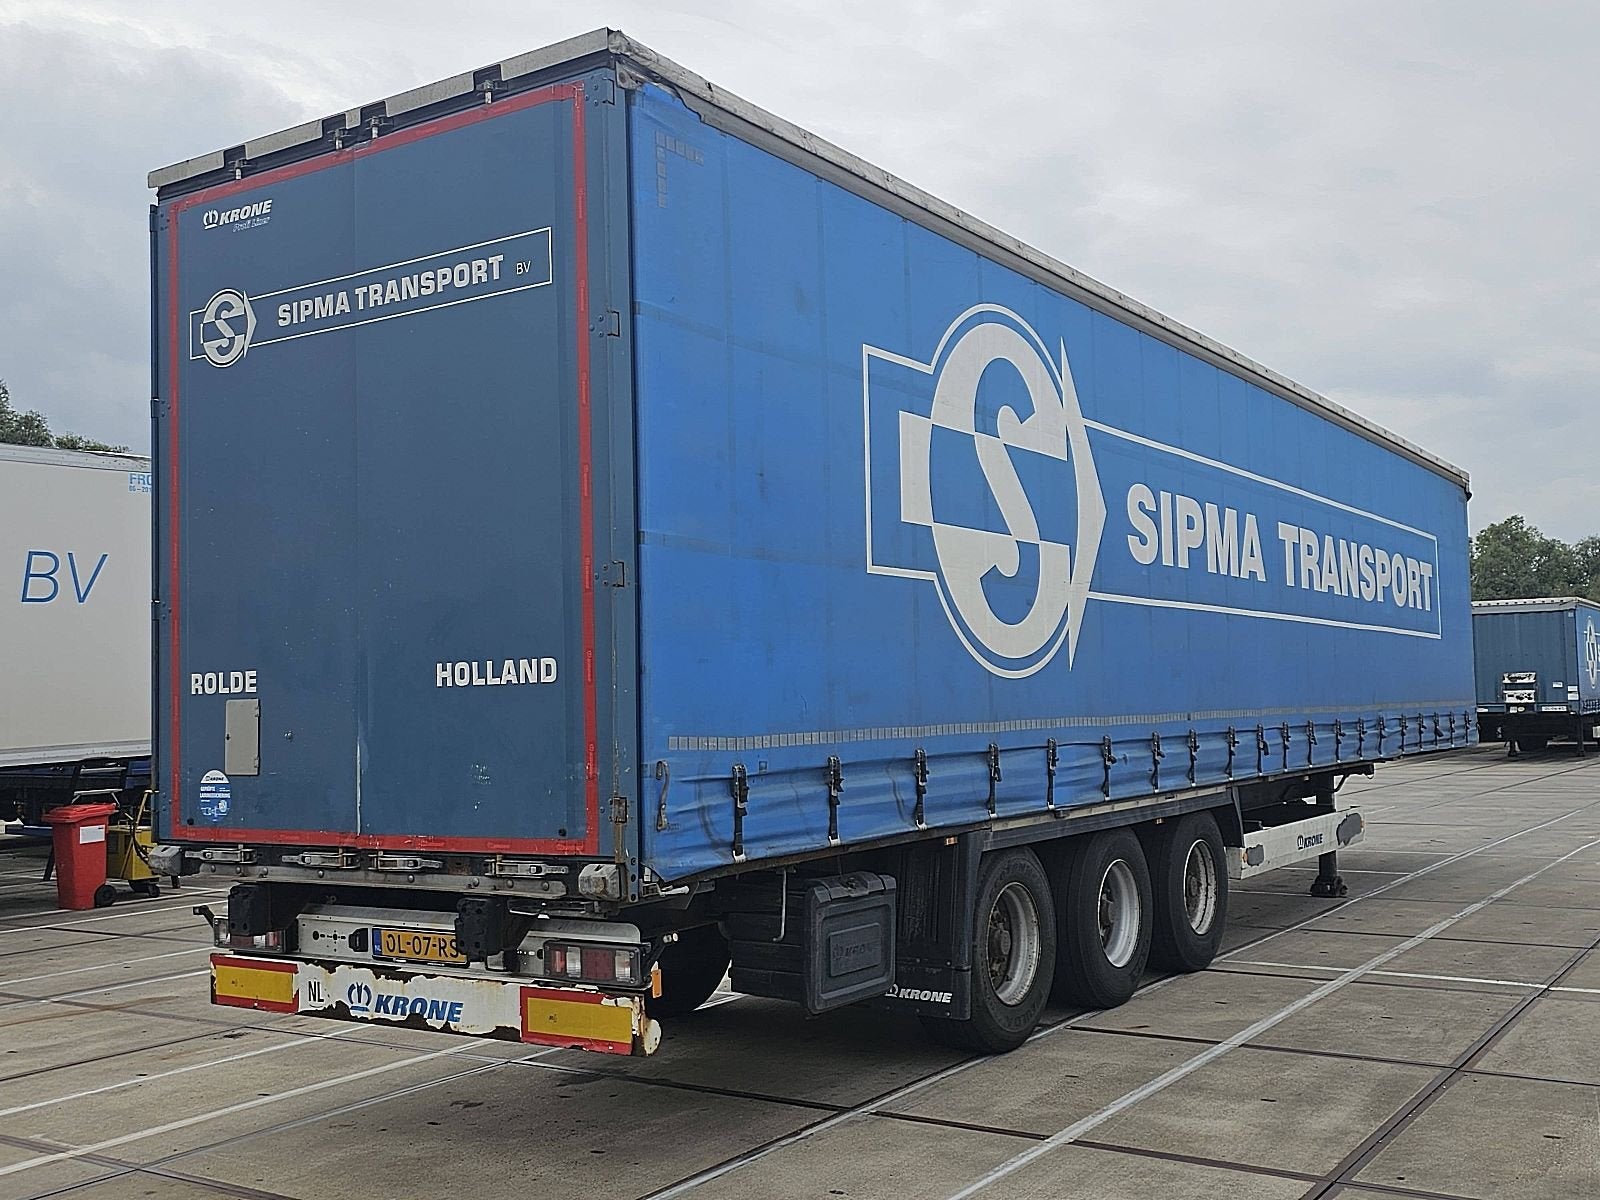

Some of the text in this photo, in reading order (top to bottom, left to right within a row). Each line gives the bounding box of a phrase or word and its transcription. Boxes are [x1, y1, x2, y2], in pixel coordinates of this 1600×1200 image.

[219, 200, 273, 225] KRONE
[278, 255, 532, 327] SIPMA TRANSPORT BV
[1126, 483, 1433, 612] SIPMA TRANSPORT
[21, 550, 109, 604] BV
[191, 670, 257, 695] ROLDE
[436, 657, 558, 687] HOLLAND
[1303, 833, 1324, 849] KRONE
[307, 981, 325, 1003] NL
[899, 988, 953, 1003] KRONE
[374, 994, 465, 1023] KRONE
